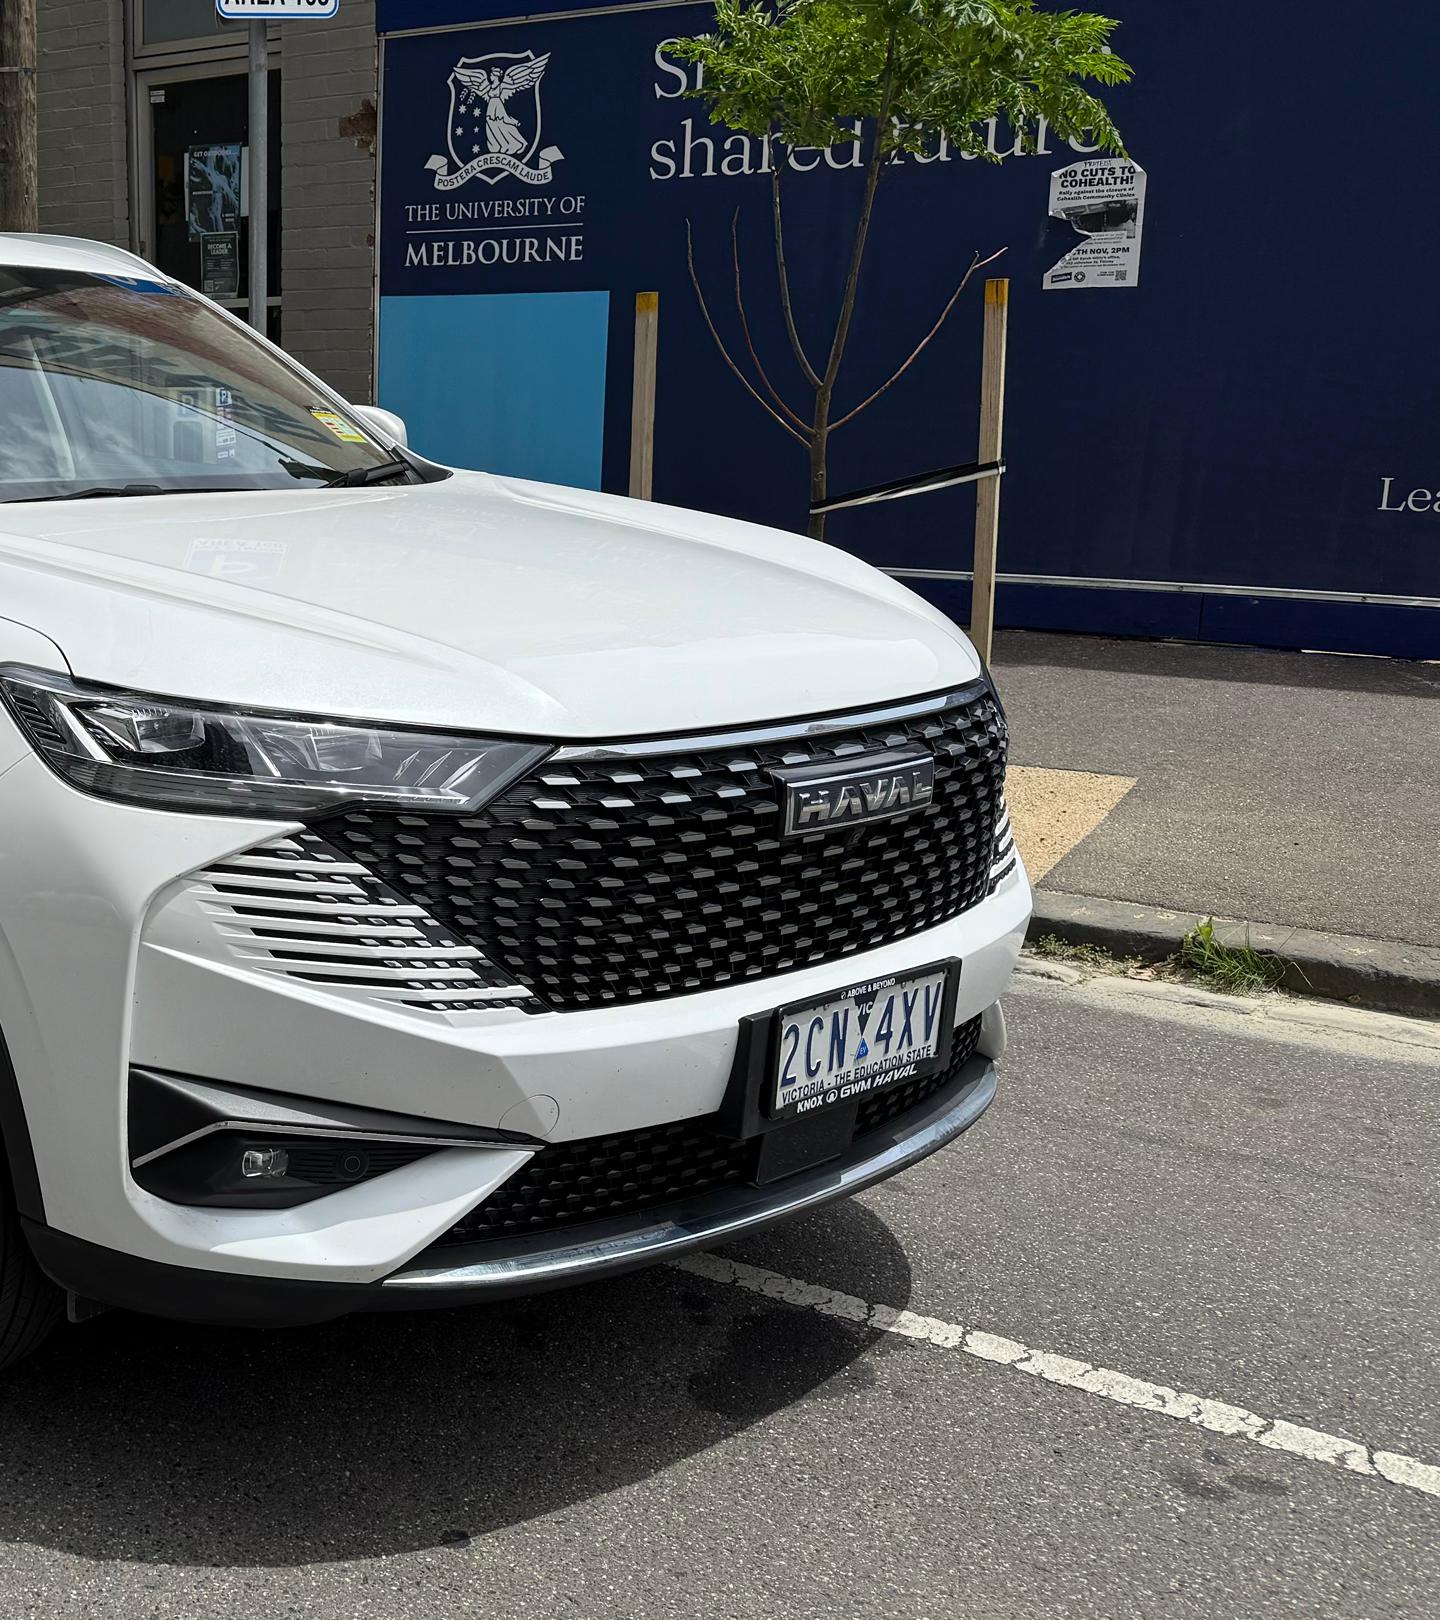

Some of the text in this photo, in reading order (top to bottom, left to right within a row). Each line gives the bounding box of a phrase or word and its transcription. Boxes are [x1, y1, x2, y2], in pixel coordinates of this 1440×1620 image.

[884, 108, 1102, 165] fuure
[437, 155, 550, 187] POSTERA CRESCAM LAUDE
[1059, 165, 1136, 179] NO CUTS TO
[1060, 175, 1134, 188] COHEALTH!
[404, 196, 586, 222] THE UNIVERSITY OF
[404, 235, 584, 267] MELBOURNE
[1073, 246, 1130, 256] TH NOV, 2PM
[798, 771, 932, 824] HAVAL
[847, 985, 867, 998] ABOVE
[873, 977, 896, 991] BEYOND
[780, 981, 942, 1088] 2CN 4XV
[782, 1079, 825, 1104] VICTORIA
[834, 1070, 852, 1085] THE
[854, 1053, 904, 1078] EDUCATION
[906, 1044, 932, 1062] STATE
[797, 1063, 918, 1114] KNOX GWM HAVAL
